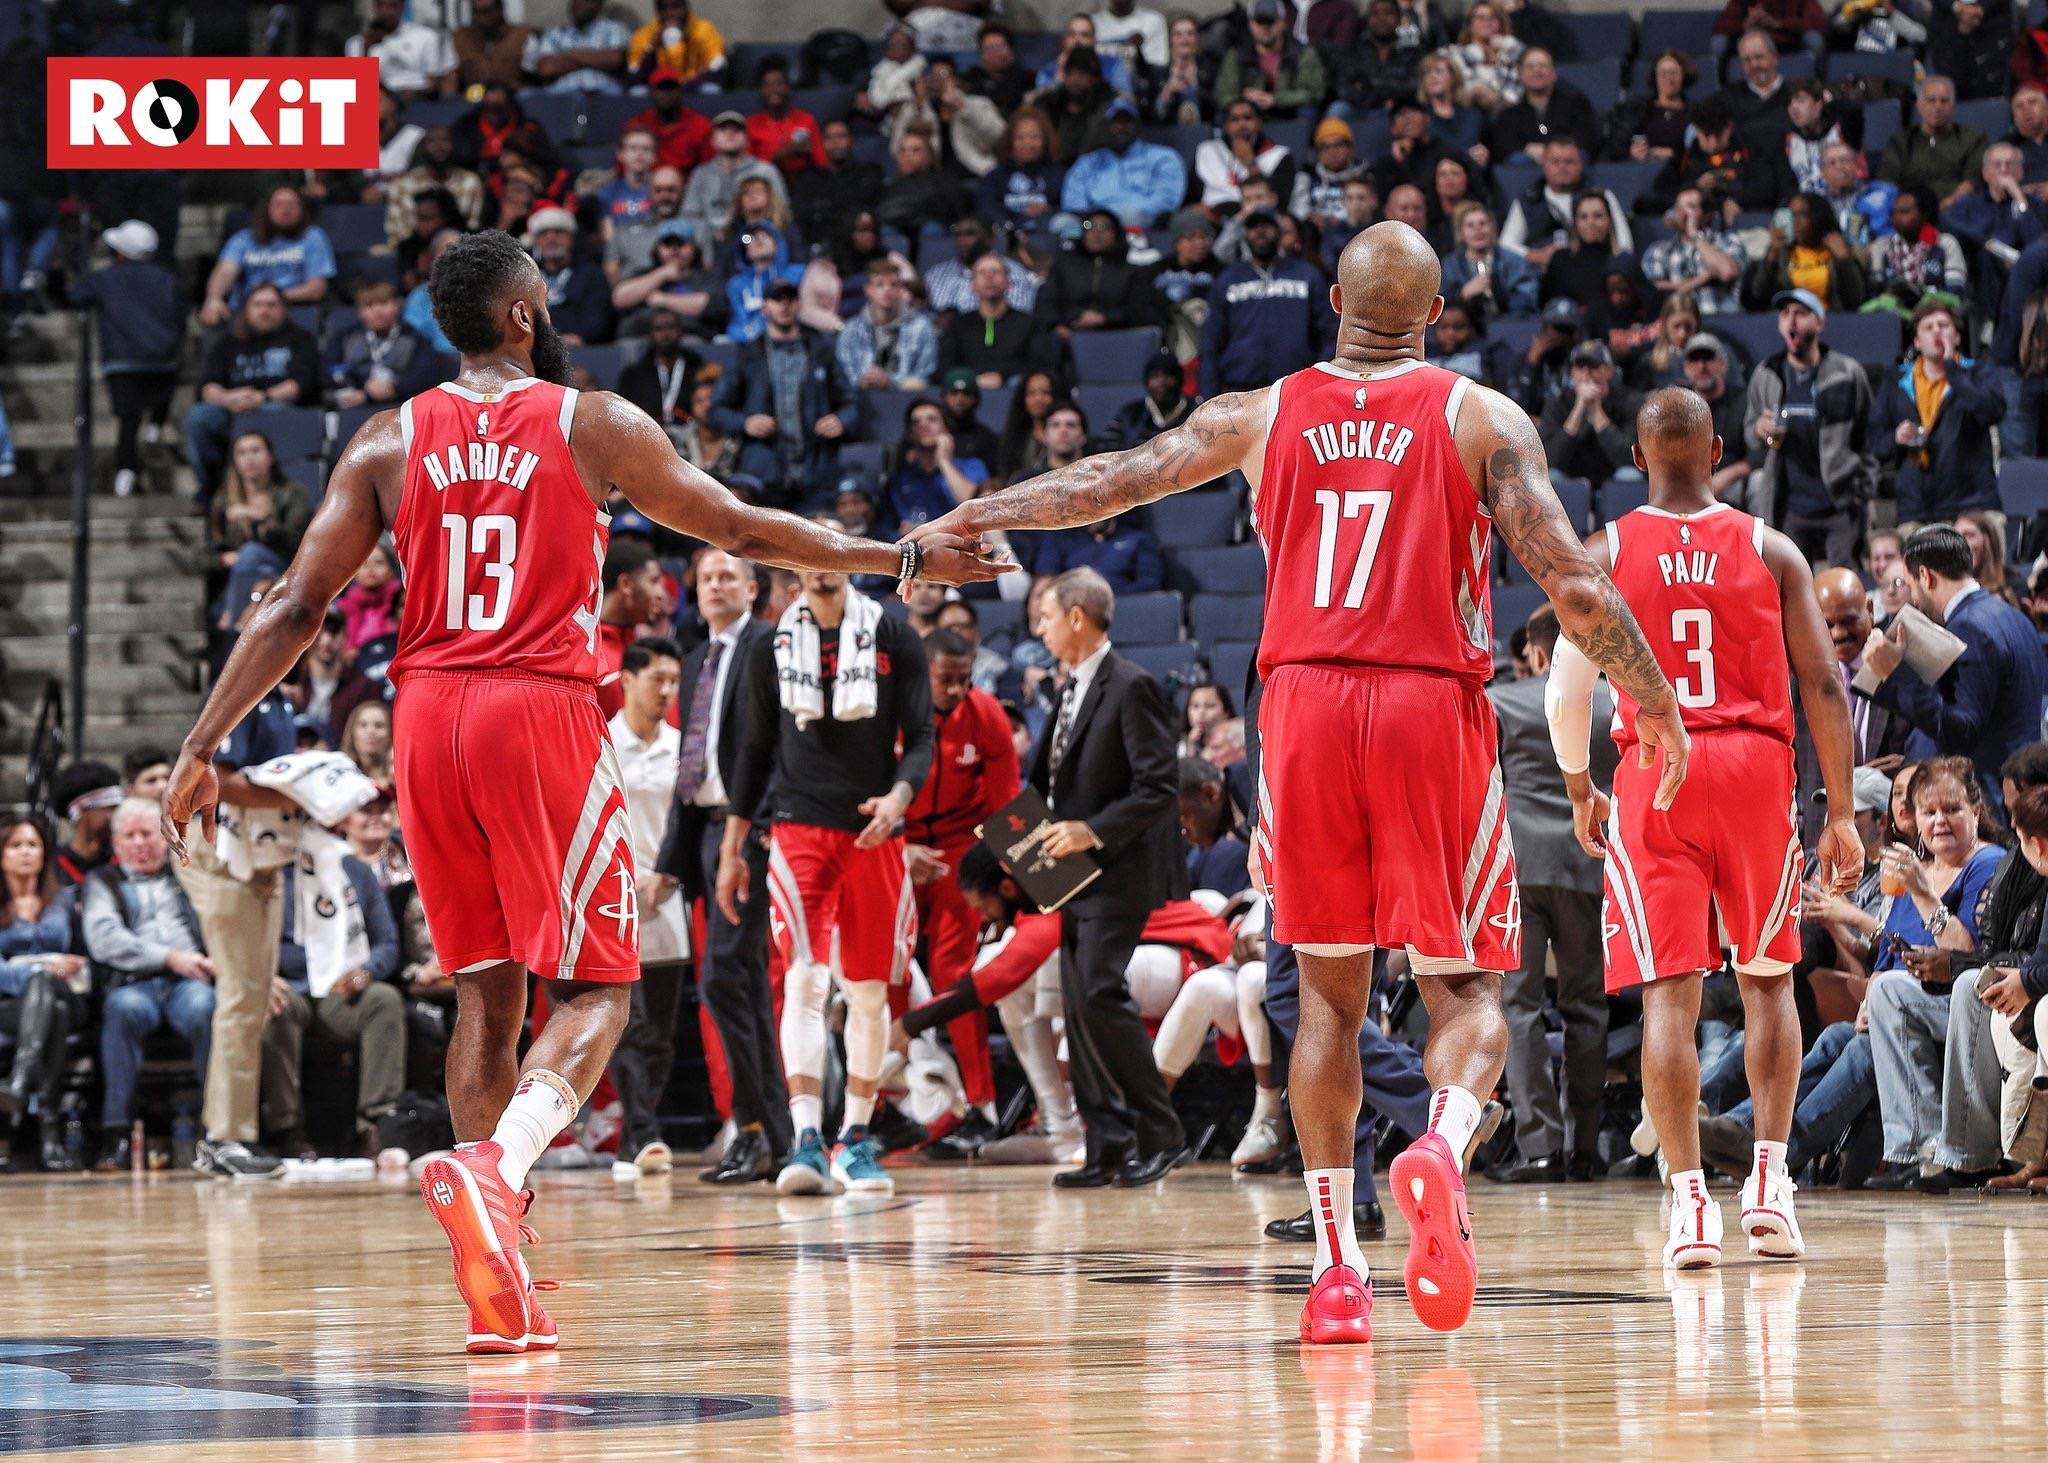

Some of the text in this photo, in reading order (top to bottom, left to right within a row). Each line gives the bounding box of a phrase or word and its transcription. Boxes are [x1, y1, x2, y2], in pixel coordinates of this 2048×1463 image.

[422, 442, 541, 492] HARDEN
[1301, 420, 1415, 466] TUCKER
[441, 513, 517, 631] 13
[1313, 489, 1393, 609] 17
[1656, 550, 1719, 587] PAUL
[1671, 608, 1717, 708] 3
